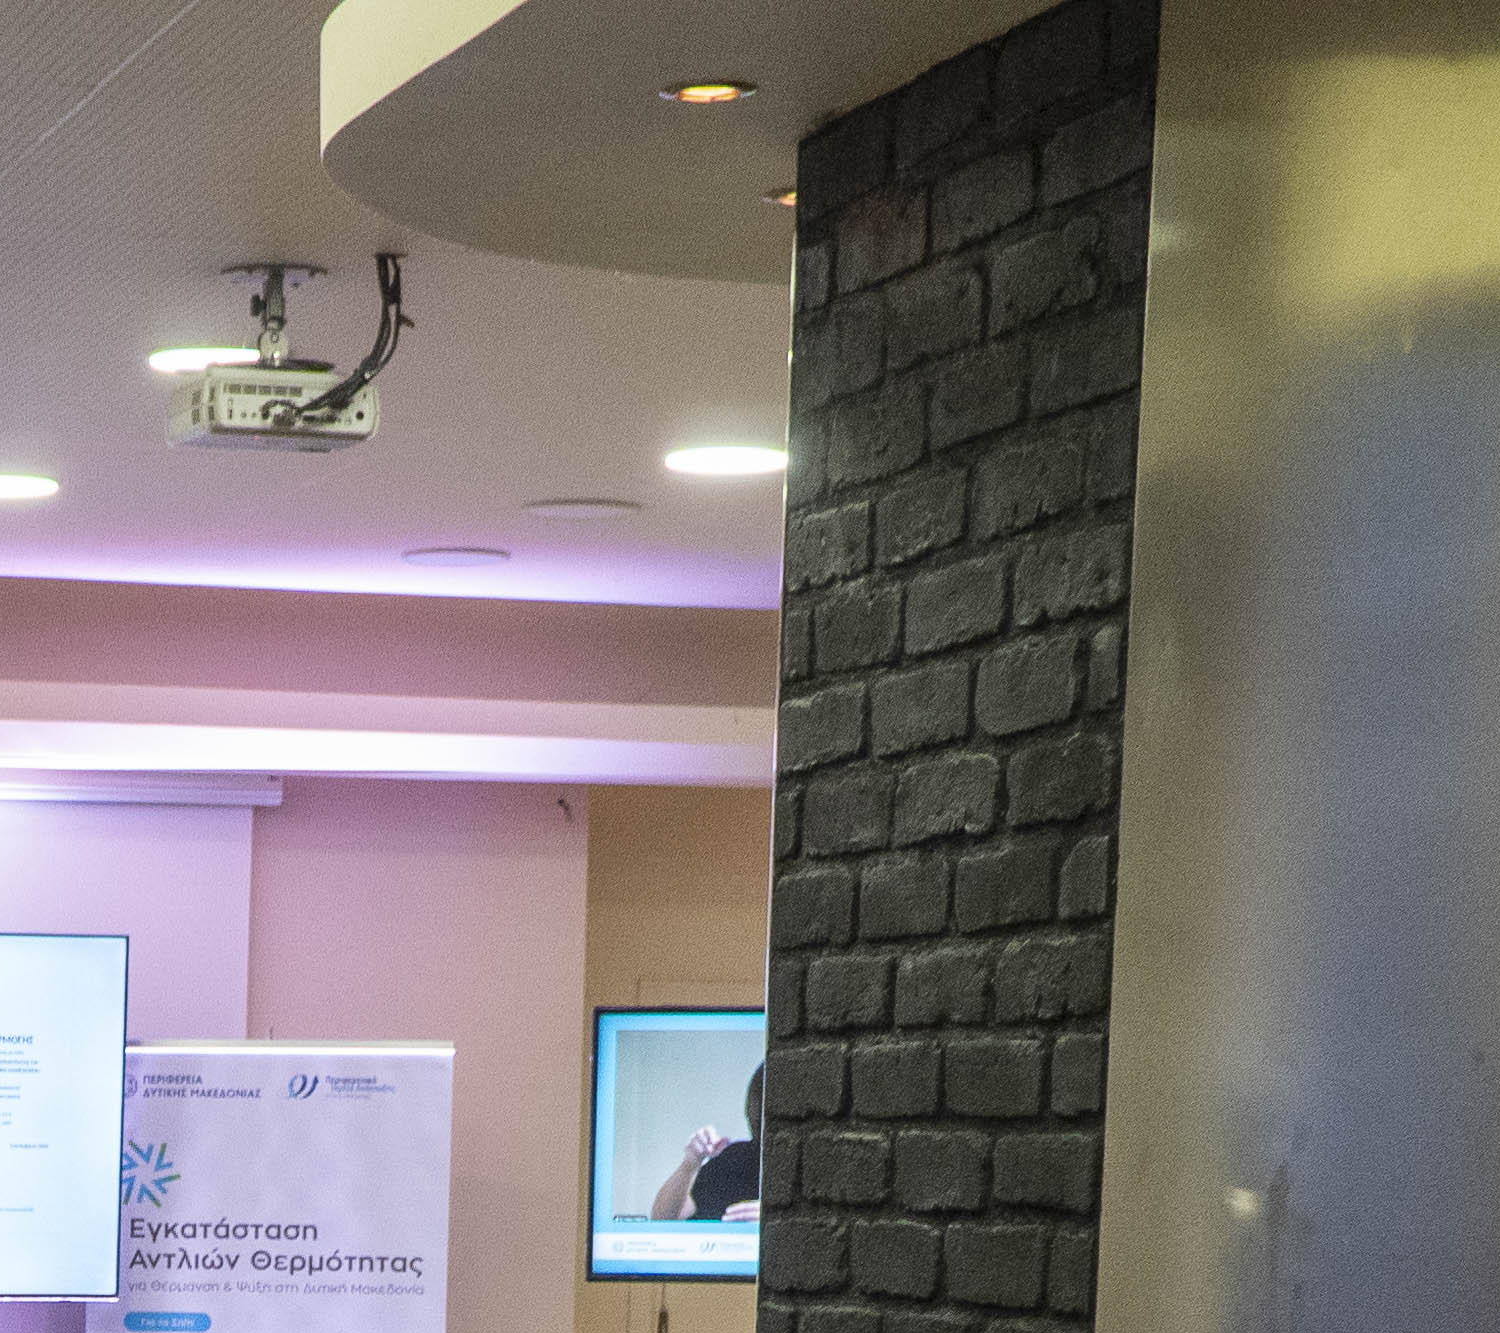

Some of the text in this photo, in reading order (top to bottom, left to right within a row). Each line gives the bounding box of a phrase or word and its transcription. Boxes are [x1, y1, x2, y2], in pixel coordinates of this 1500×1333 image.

[142, 1088, 262, 1099] ΔΥΤΙΚΗΣ ΜΑΚΕΔΟΝΙΑΣ
[129, 1218, 318, 1244] Εγκατάσταση
[128, 1248, 424, 1277] Αντλιών Θερμότητας
